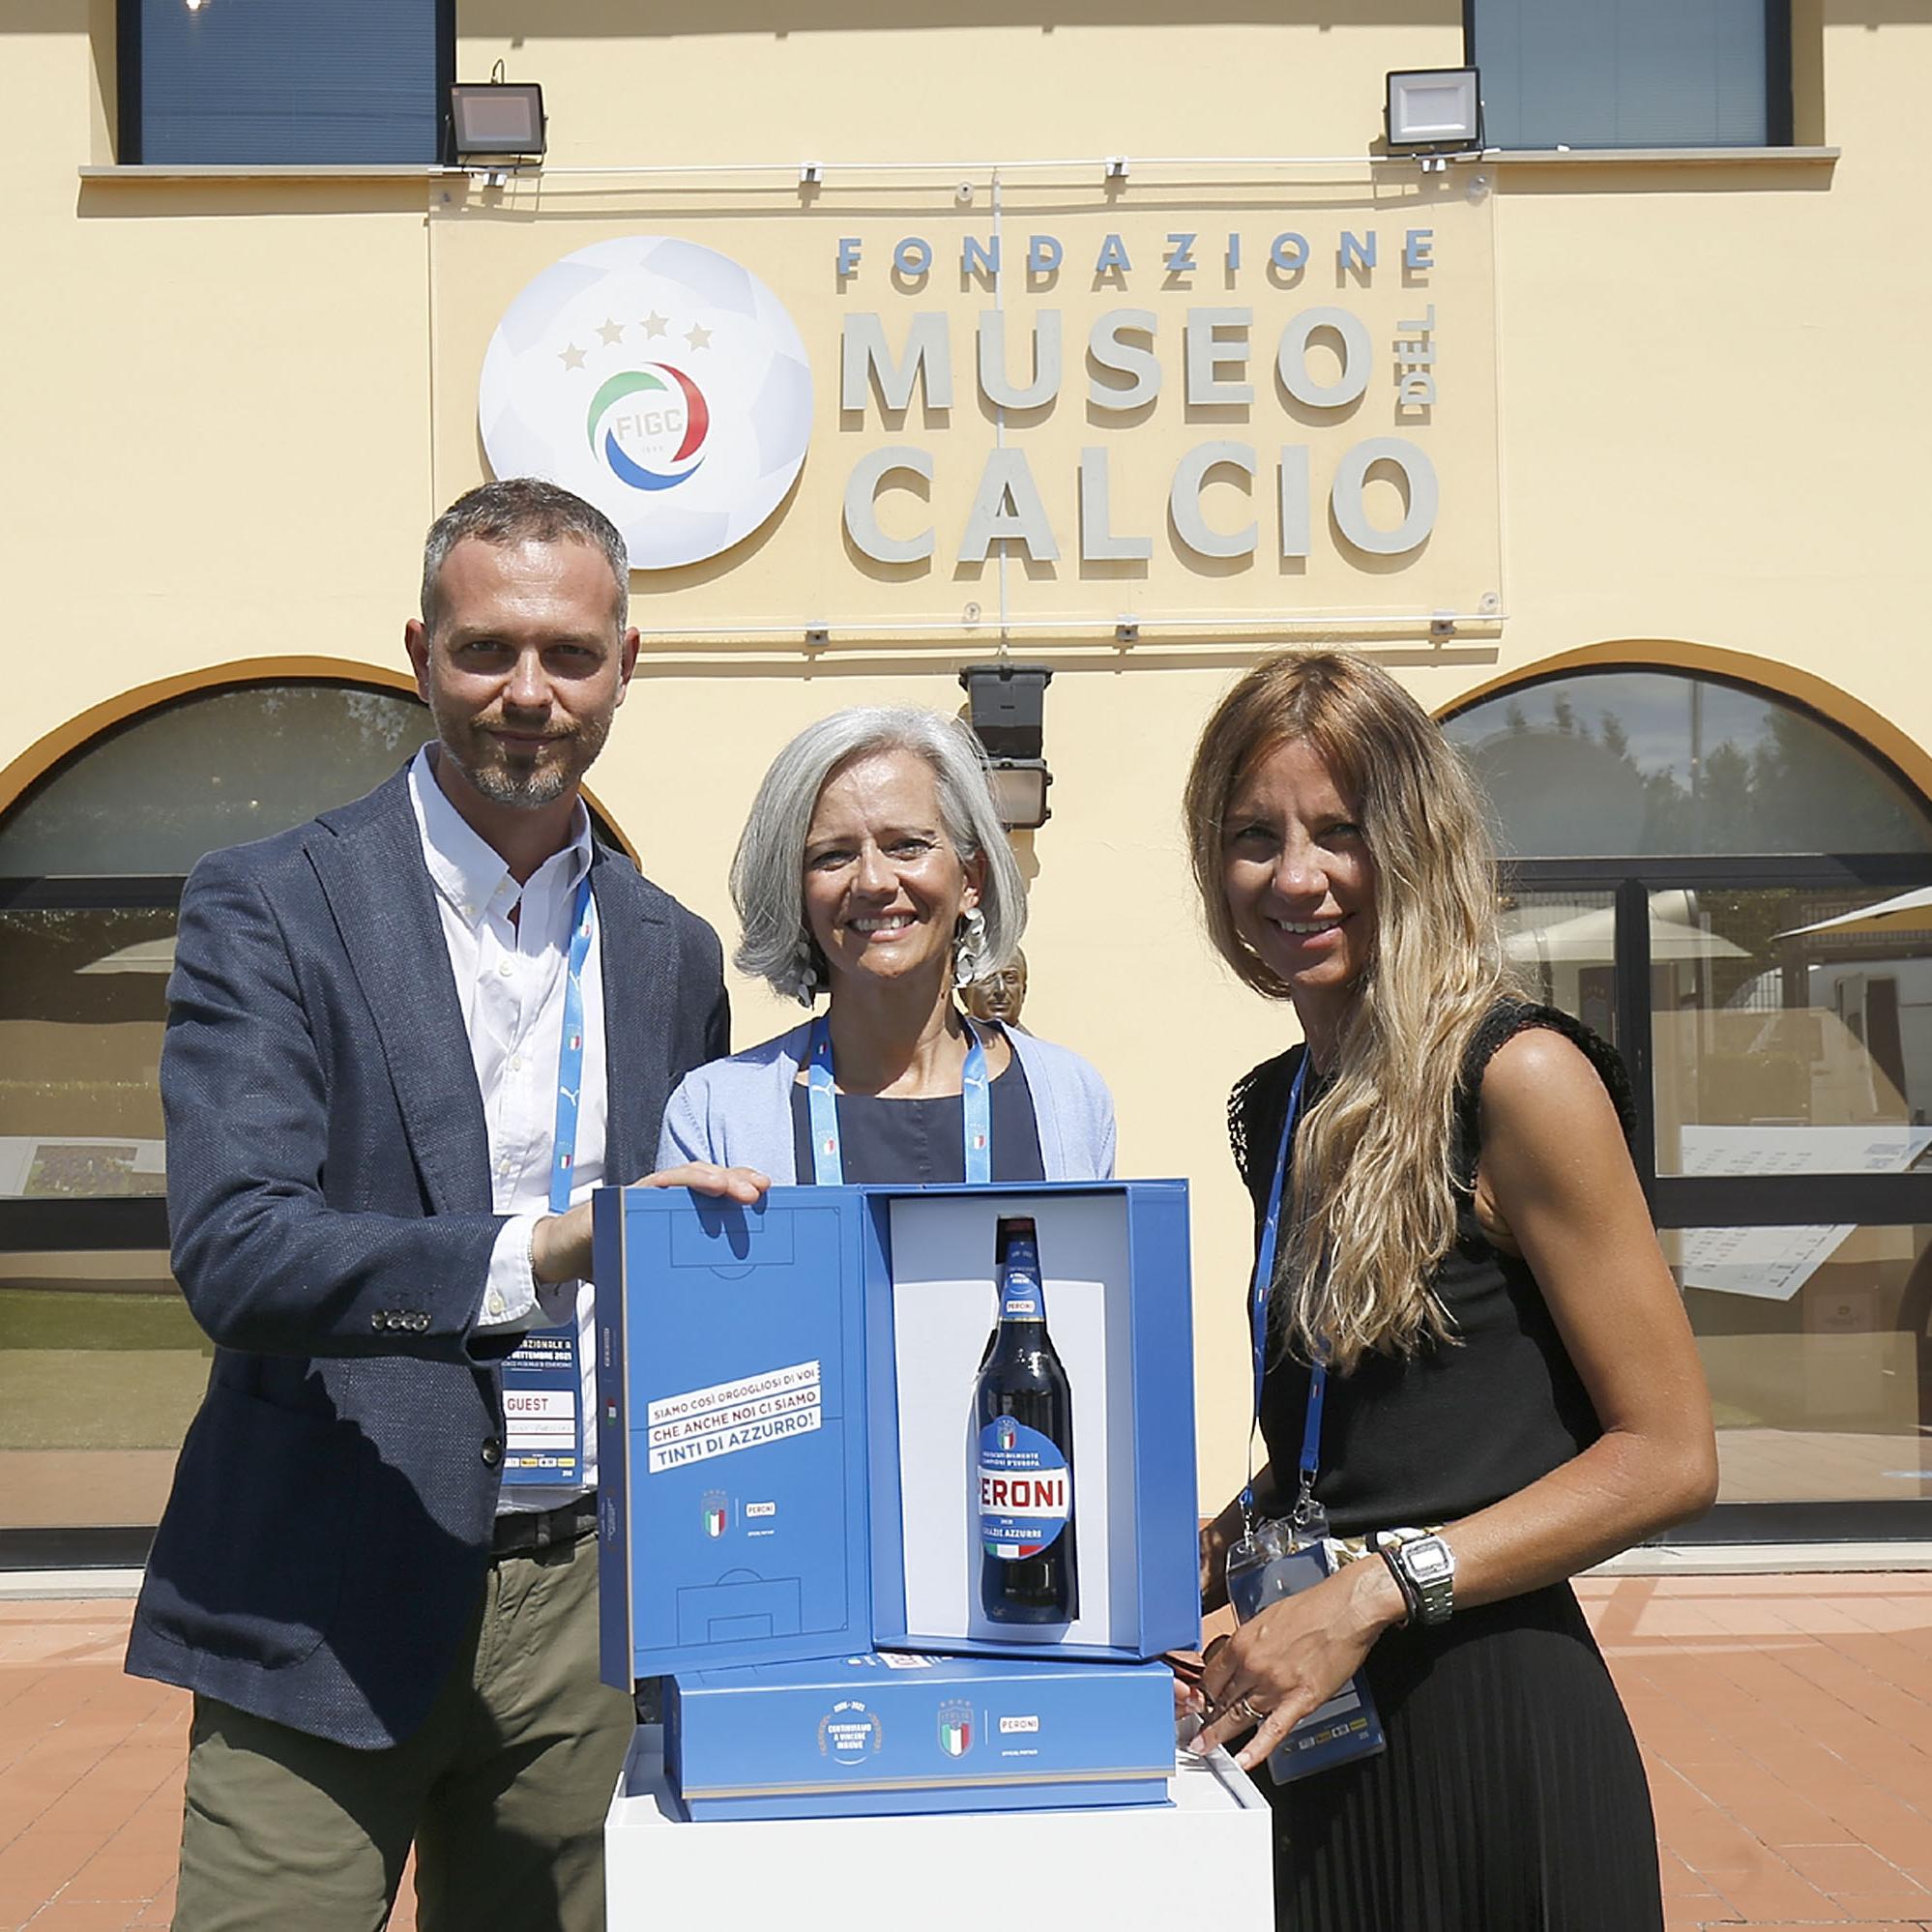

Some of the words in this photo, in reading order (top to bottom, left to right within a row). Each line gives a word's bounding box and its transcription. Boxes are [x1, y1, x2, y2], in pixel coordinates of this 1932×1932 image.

[838, 229, 1435, 275] FONDAZIONE
[842, 306, 1373, 410] MUSEO
[1396, 304, 1436, 404] DEL
[616, 408, 683, 441] FIGC
[843, 437, 1440, 564] CALCIO
[507, 1397, 549, 1411] GUEST
[654, 1402, 688, 1420] SIAMO
[690, 1392, 716, 1410] COSÌ
[718, 1377, 782, 1403] ORGOGLIOSI
[783, 1374, 796, 1385] DI
[797, 1368, 815, 1381] VOI
[654, 1425, 680, 1442] CHE
[684, 1414, 729, 1435] ANCHE
[732, 1406, 756, 1421] NOI
[759, 1402, 772, 1415] CI
[776, 1391, 816, 1411] SIAMO
[658, 1442, 702, 1465] TINTI
[707, 1436, 723, 1452] DI
[728, 1412, 815, 1447] AZZURRO!
[747, 1505, 775, 1515] PERONI
[1001, 1719, 1038, 1730] PERONI
